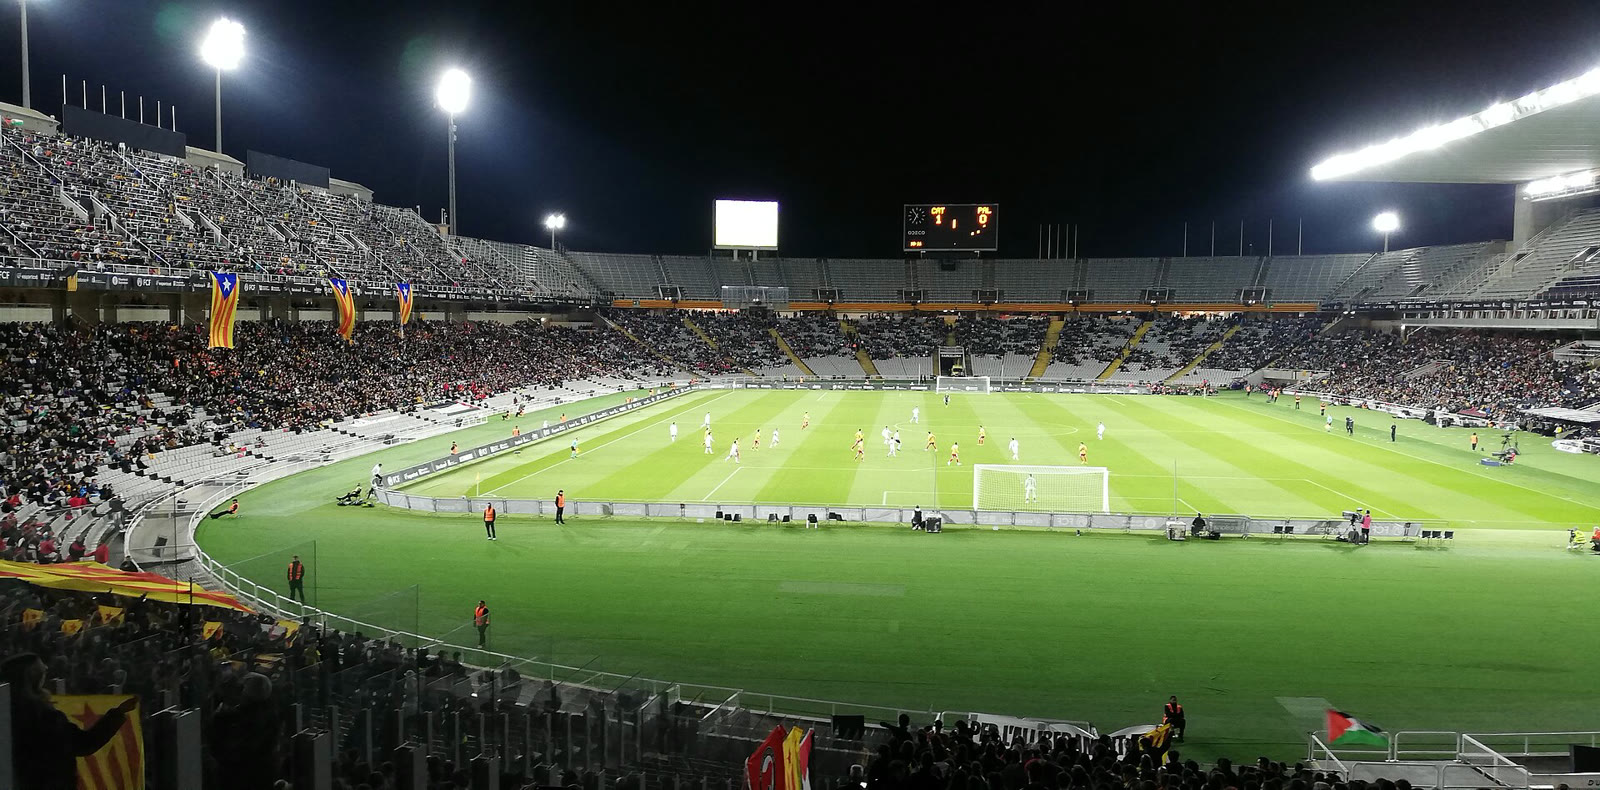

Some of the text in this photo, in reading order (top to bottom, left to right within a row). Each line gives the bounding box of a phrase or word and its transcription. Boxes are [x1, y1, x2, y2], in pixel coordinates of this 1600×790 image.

[931, 207, 945, 215] CAT
[935, 215, 942, 225] 1
[979, 214, 988, 224] 0
